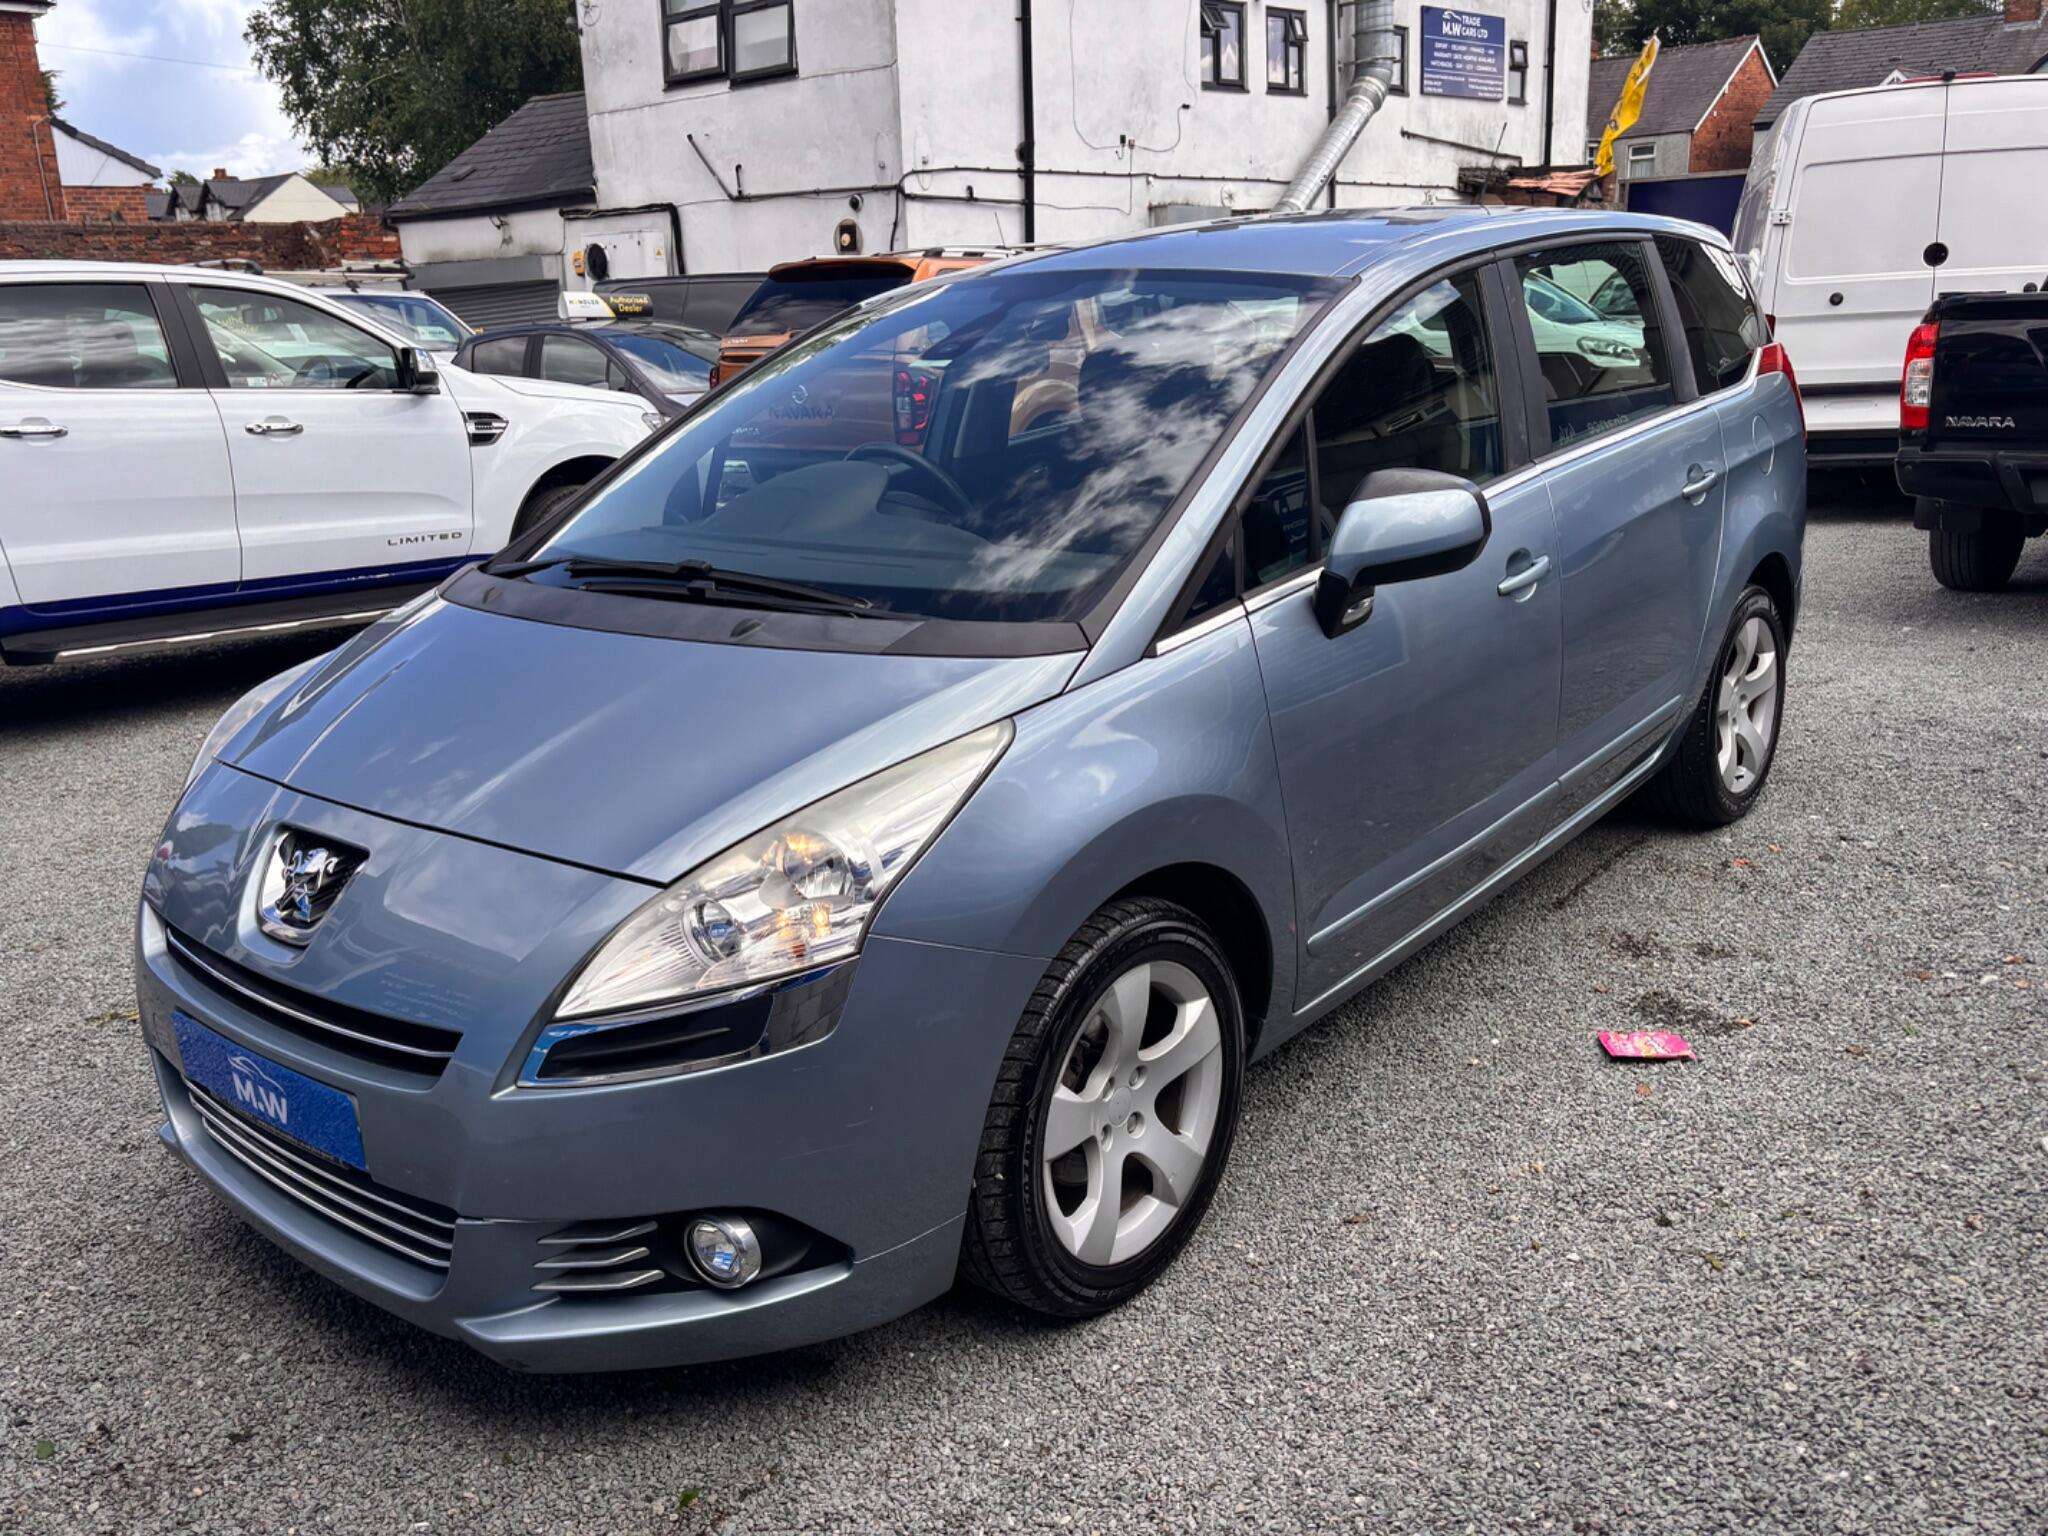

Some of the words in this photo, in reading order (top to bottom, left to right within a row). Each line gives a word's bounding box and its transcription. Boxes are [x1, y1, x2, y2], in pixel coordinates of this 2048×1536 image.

[1462, 15, 1481, 27] TRADE
[1462, 27, 1477, 37] CARS
[1945, 415, 2015, 428] NAVARA
[387, 531, 463, 546] LIMITED
[232, 1071, 288, 1125] M.W
